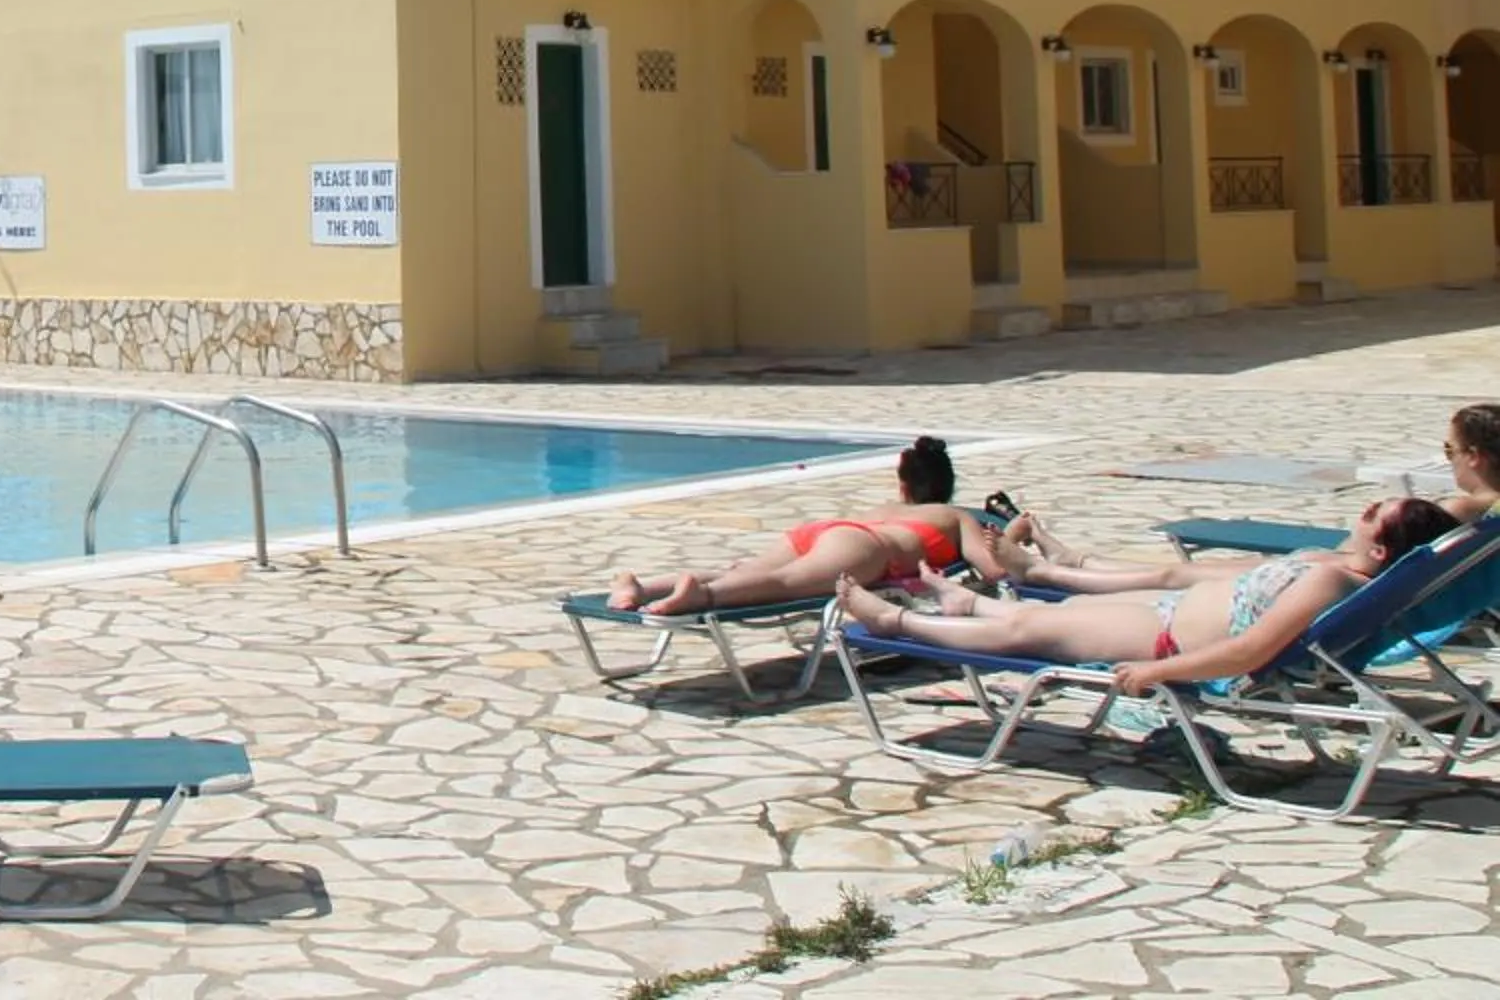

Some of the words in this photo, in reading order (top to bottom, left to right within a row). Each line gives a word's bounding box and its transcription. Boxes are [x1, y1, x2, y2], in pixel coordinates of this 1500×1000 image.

[313, 170, 351, 187] PLEASE
[355, 170, 369, 186] DO
[371, 169, 393, 186] NOT
[314, 195, 341, 212] BRING
[344, 195, 369, 212] SAND
[372, 195, 395, 212] INTO
[326, 219, 349, 236] THE
[352, 219, 384, 237] POOL
